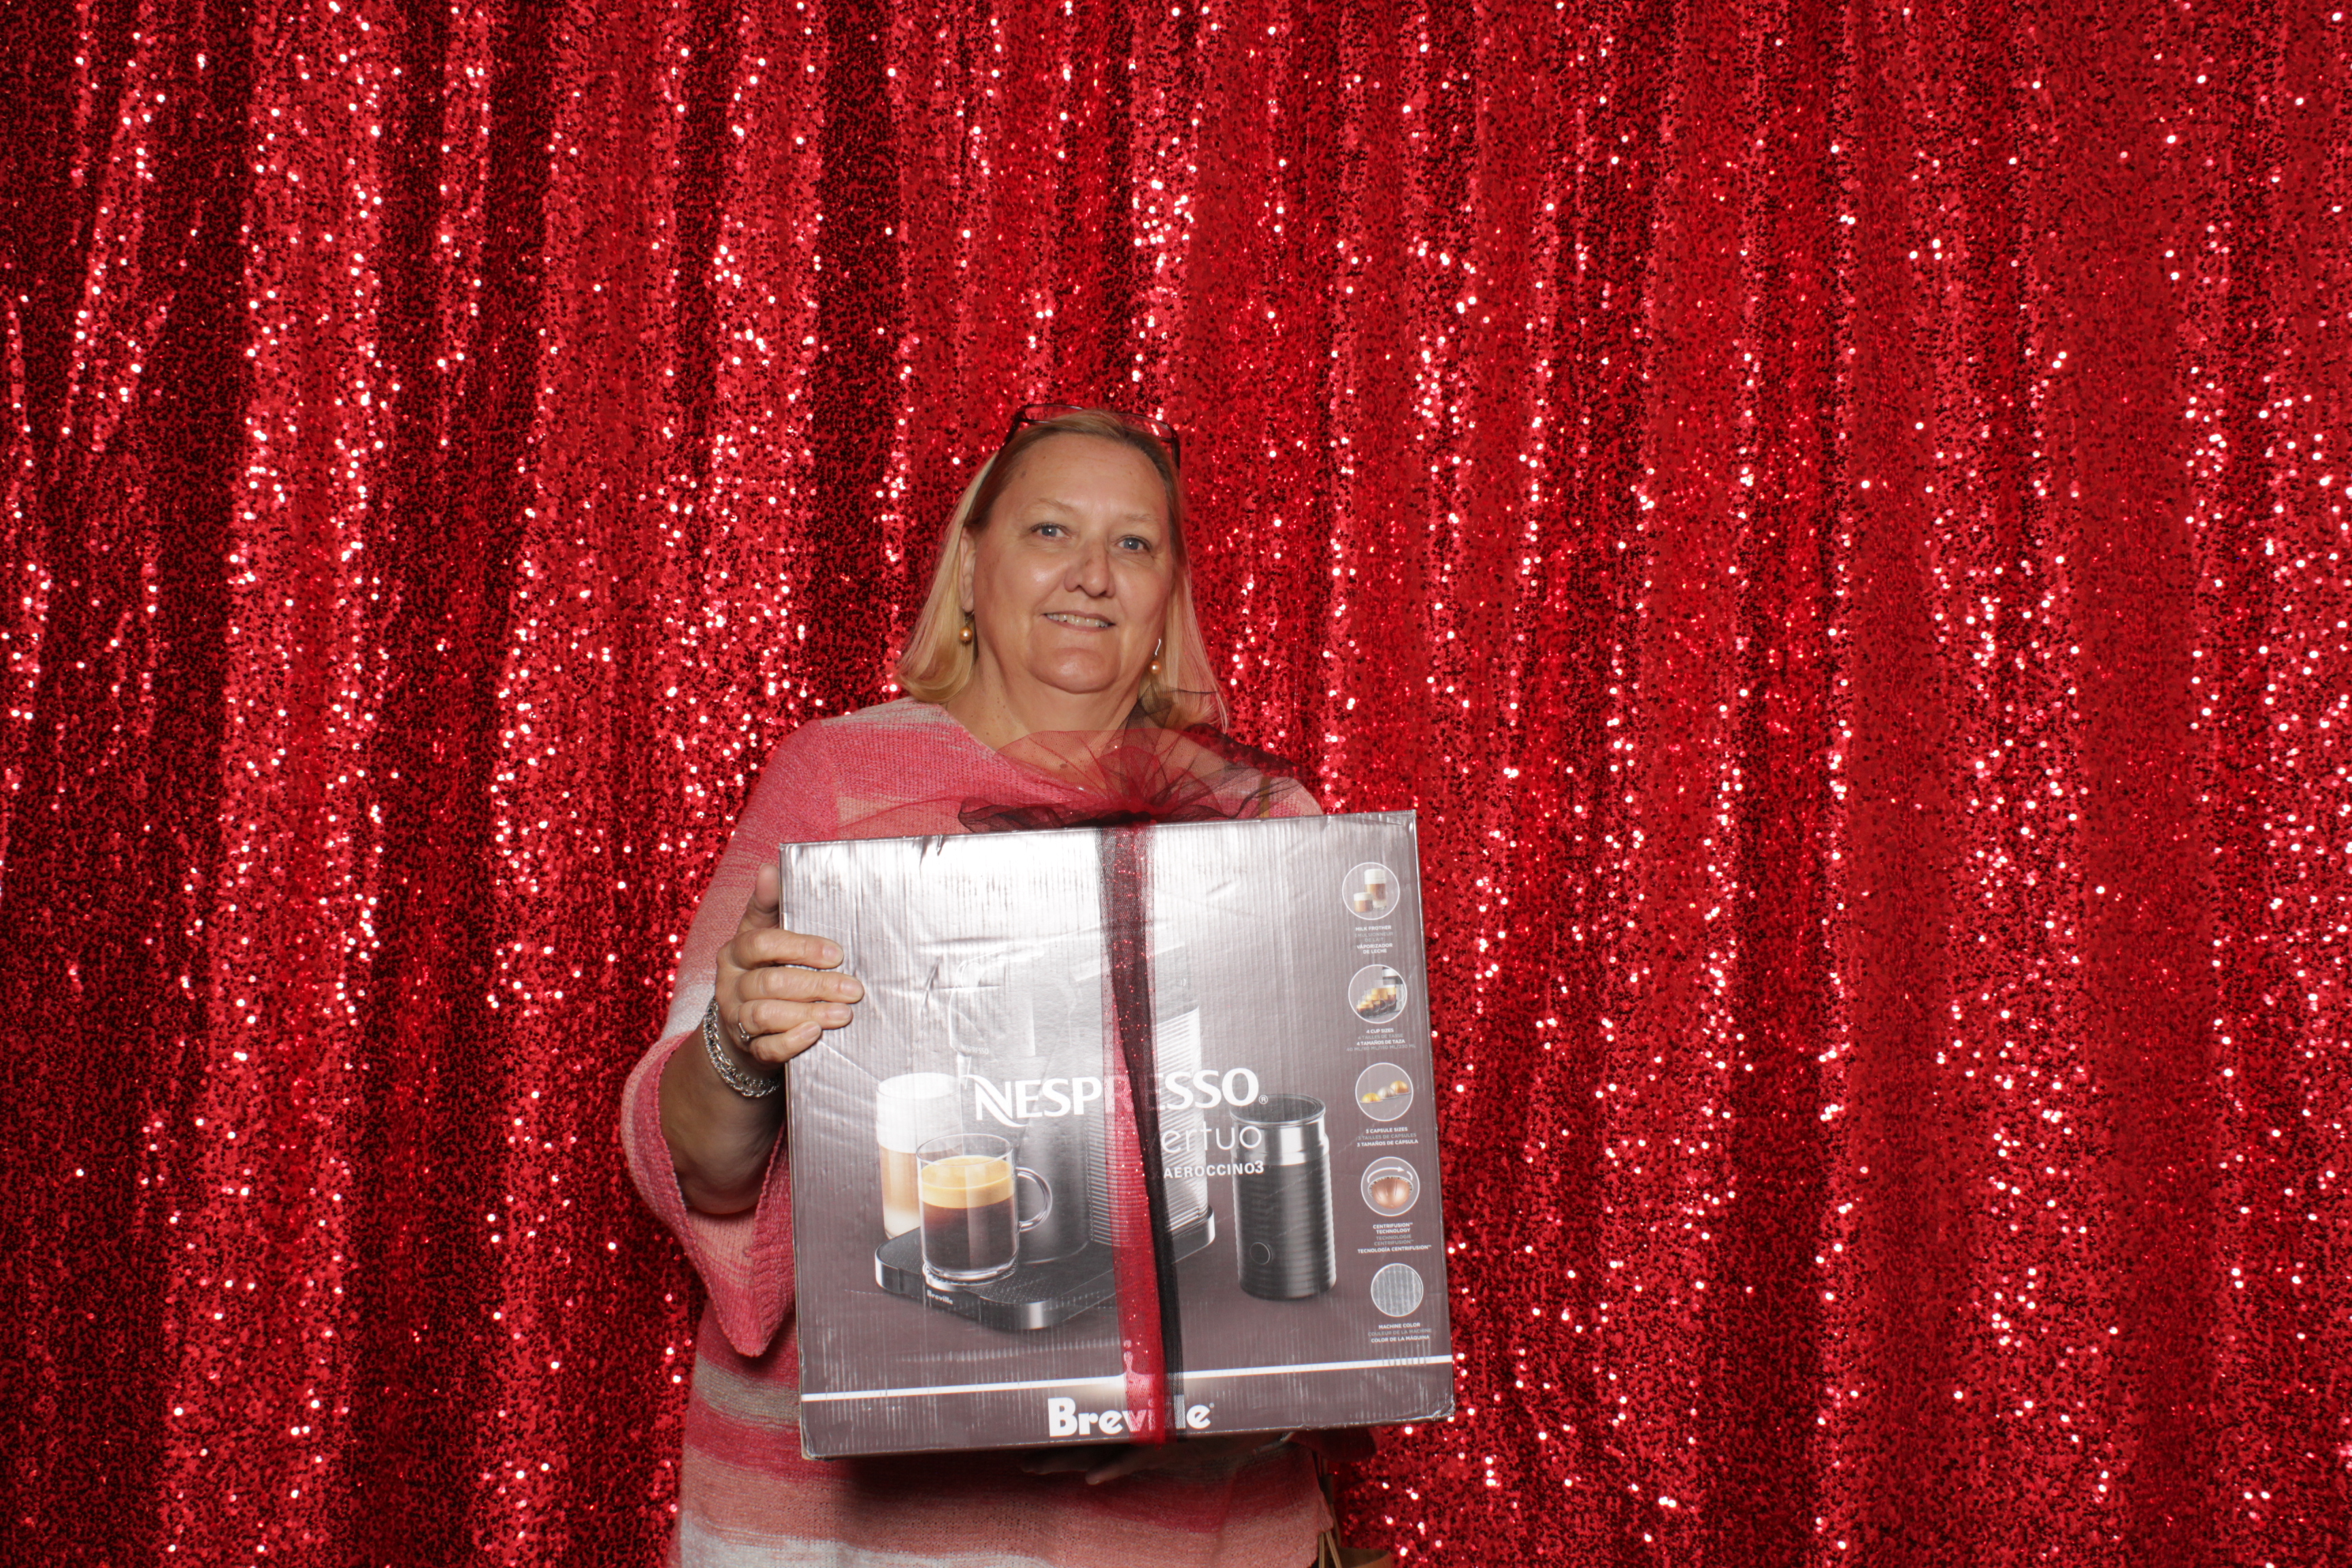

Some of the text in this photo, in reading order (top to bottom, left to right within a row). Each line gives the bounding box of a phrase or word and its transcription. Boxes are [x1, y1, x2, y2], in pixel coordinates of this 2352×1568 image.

[1161, 1122, 1262, 1154] ertuo
[1163, 1160, 1264, 1179] AEROCCINO3
[1048, 1394, 1211, 1437] Brevile
